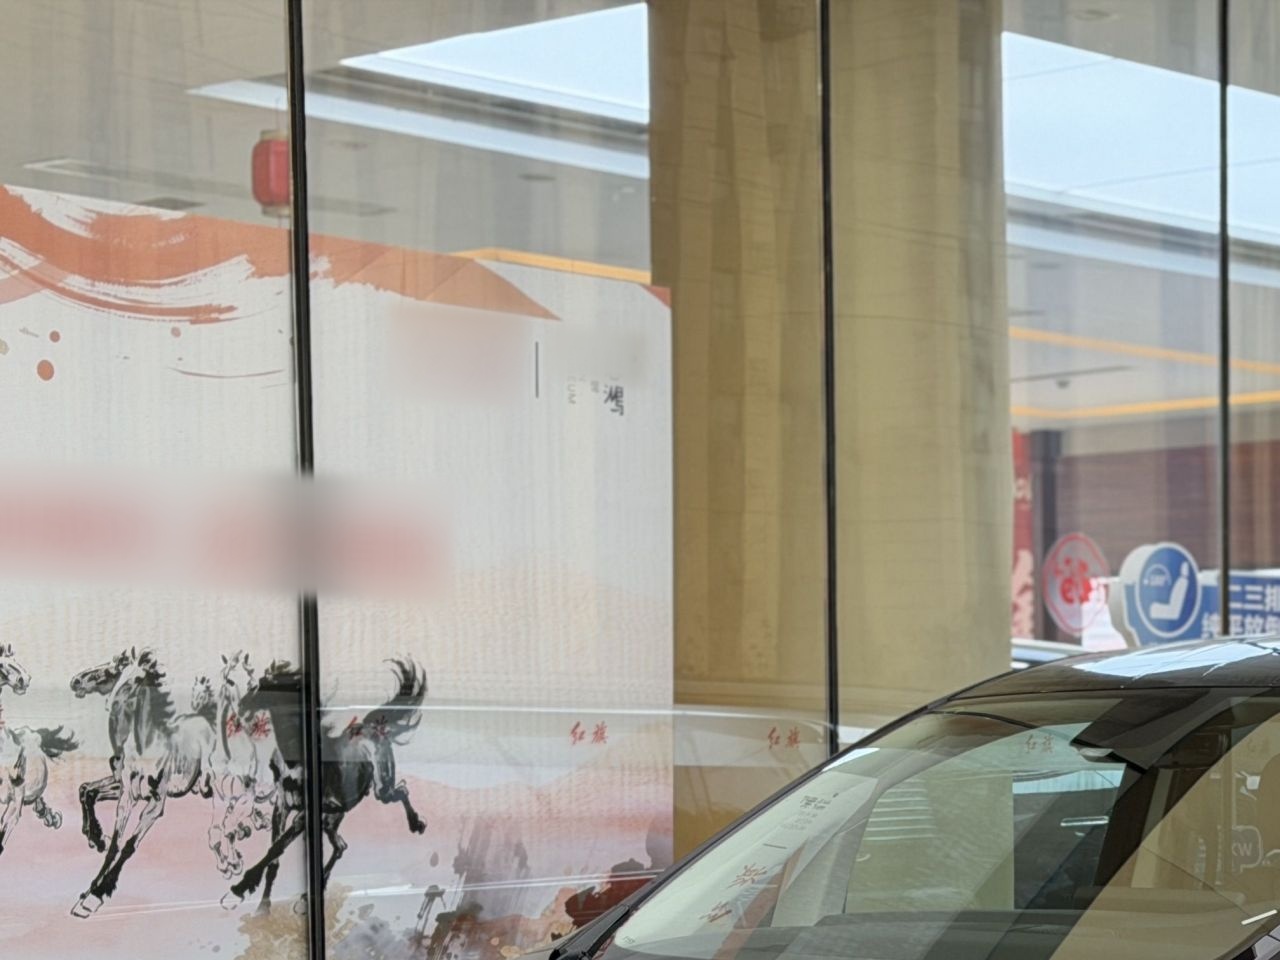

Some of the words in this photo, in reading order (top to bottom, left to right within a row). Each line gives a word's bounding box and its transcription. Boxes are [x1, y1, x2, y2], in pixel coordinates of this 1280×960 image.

[226, 712, 271, 739] 红旗
[570, 720, 608, 745] 红旗
[767, 726, 801, 749] 红旗
